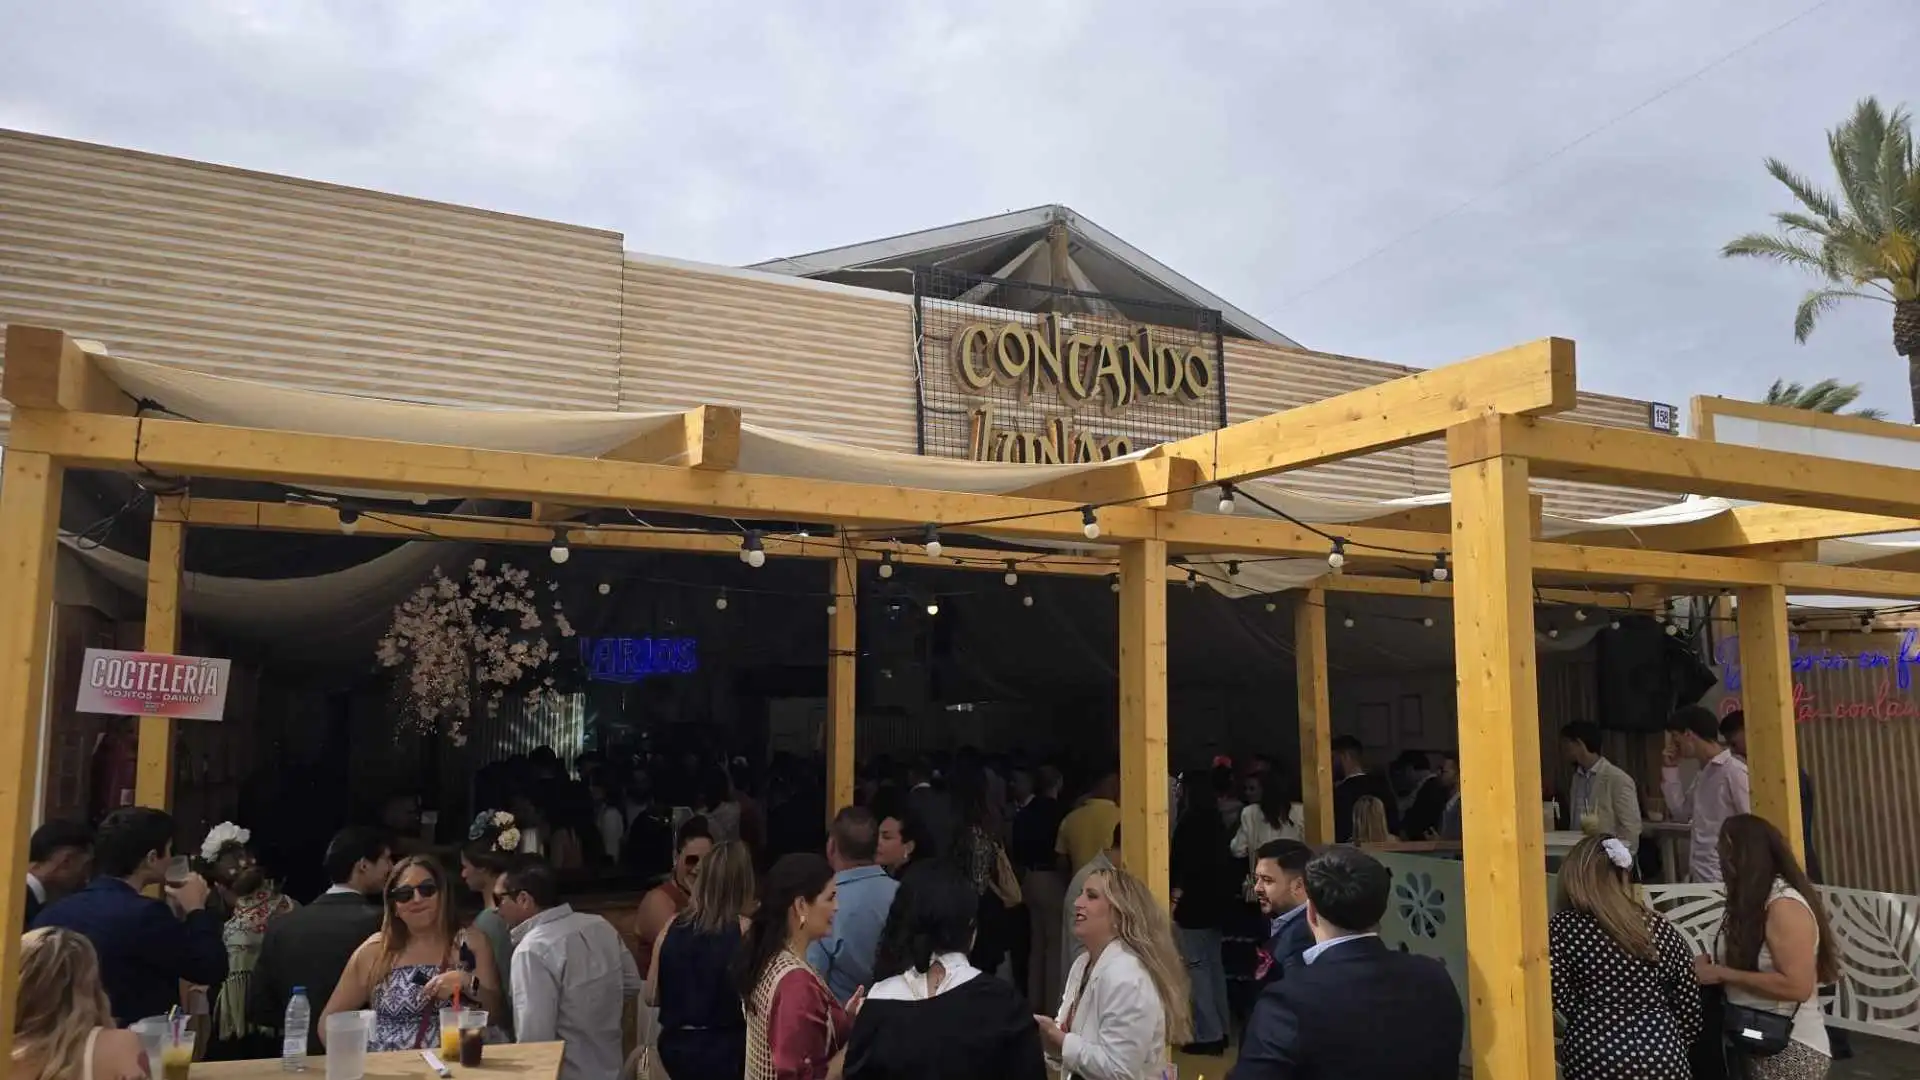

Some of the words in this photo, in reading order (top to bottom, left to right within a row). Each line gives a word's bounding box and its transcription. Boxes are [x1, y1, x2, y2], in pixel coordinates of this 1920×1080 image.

[957, 312, 1213, 408] CONTANDO
[91, 656, 219, 696] COCTELERÍA
[104, 689, 153, 701] MOJITOS
